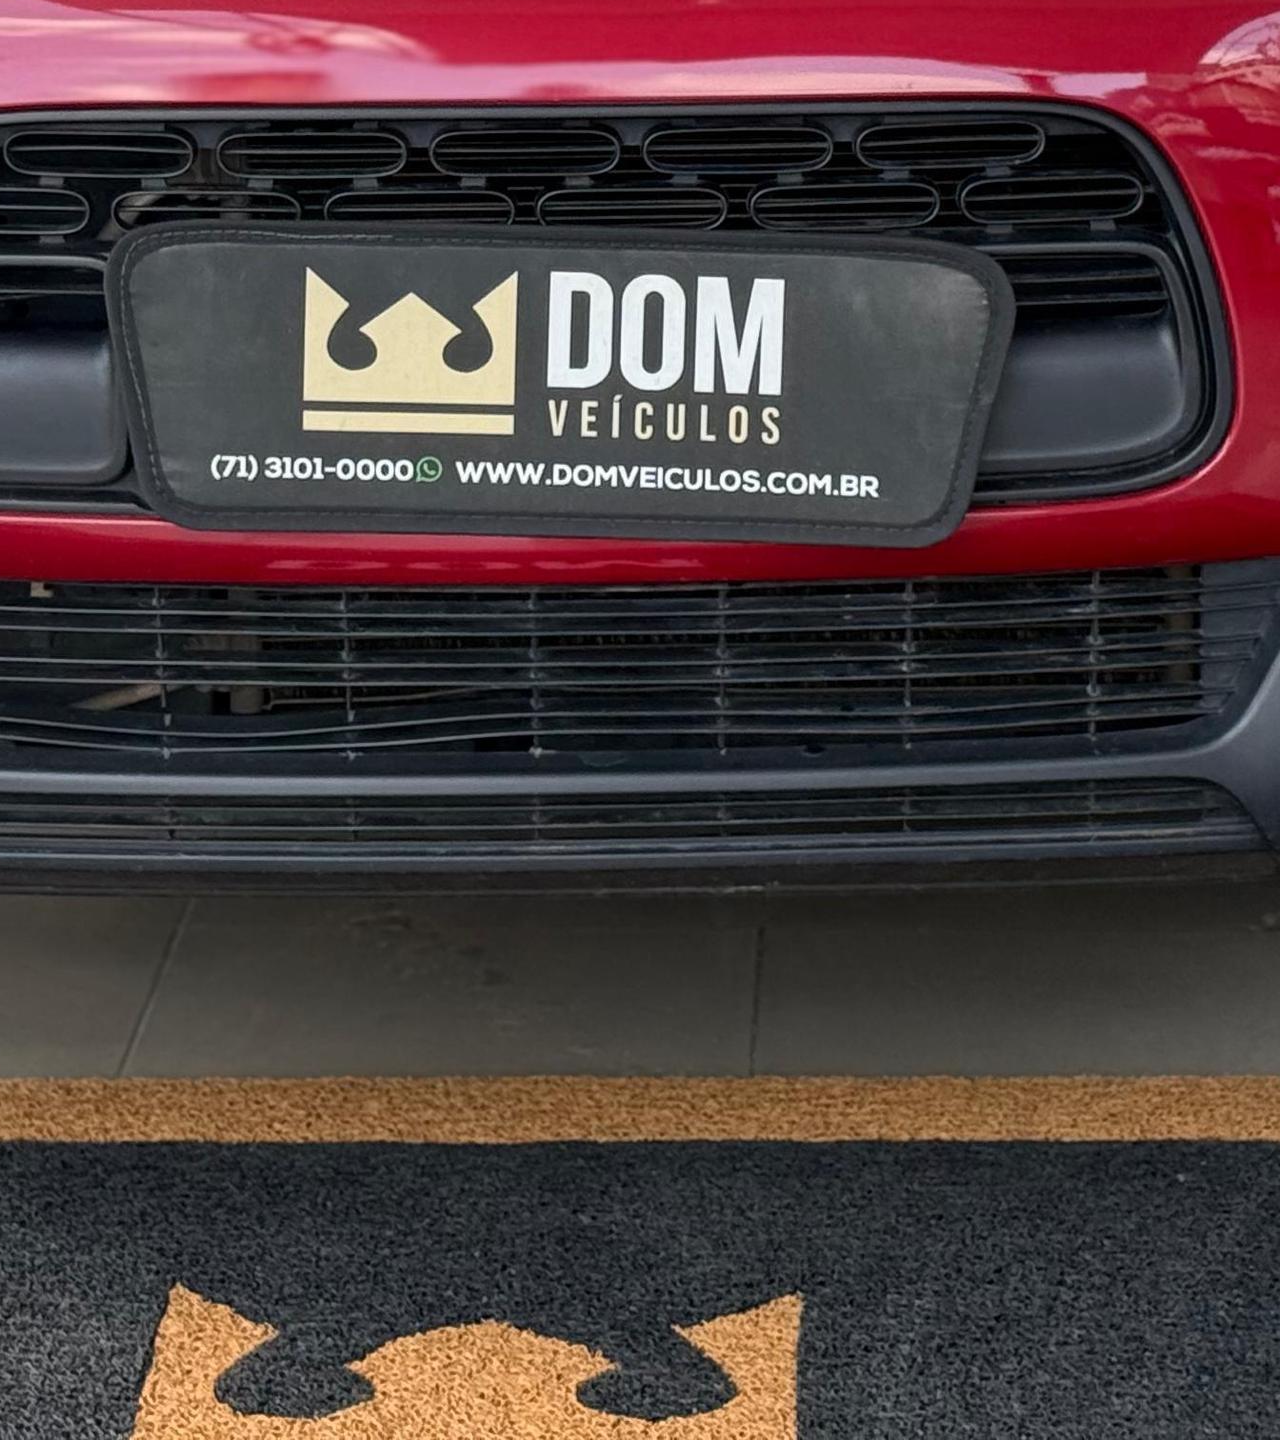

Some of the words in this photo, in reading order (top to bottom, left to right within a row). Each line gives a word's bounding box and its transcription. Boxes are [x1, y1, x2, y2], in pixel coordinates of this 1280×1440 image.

[546, 270, 786, 397] DOM
[547, 395, 782, 446] VEÍCULOS
[210, 453, 259, 482] (71)
[264, 456, 414, 482] 3101-0000
[455, 459, 881, 499] WWW.DOMVEICULOS.COM.BR
